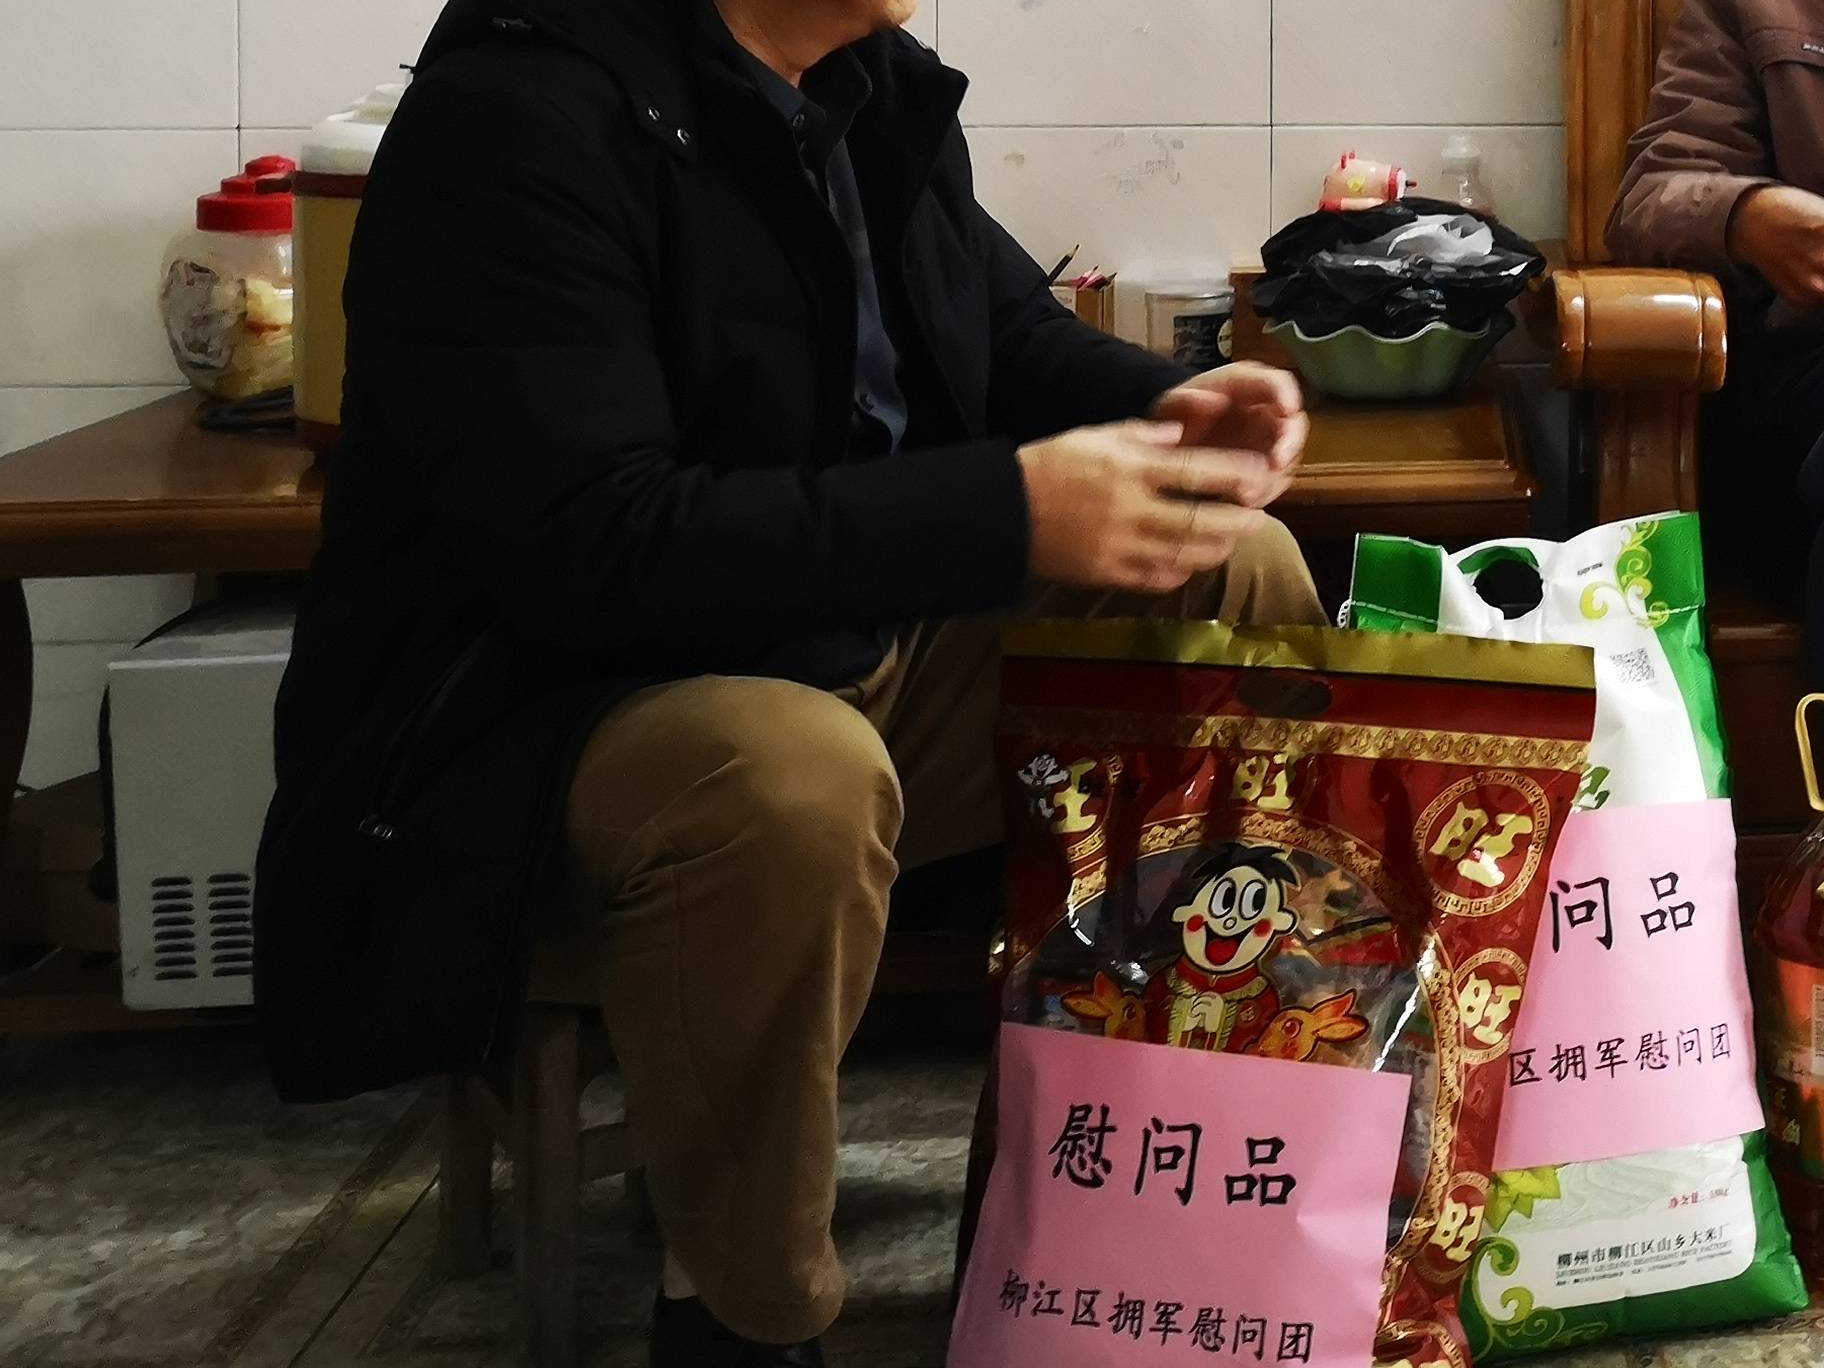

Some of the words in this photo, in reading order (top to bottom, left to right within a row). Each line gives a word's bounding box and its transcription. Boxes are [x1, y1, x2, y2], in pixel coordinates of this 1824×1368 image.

[1427, 801, 1534, 888] 旺
[1549, 872, 1696, 953] 问品
[1458, 972, 1522, 1045] 旺
[1508, 1023, 1731, 1088] 区拥军慰问团
[1048, 1103, 1297, 1206] 慰问品
[1429, 1196, 1486, 1263] 旺
[999, 1268, 1315, 1364] 柳江区拥军慰问团
